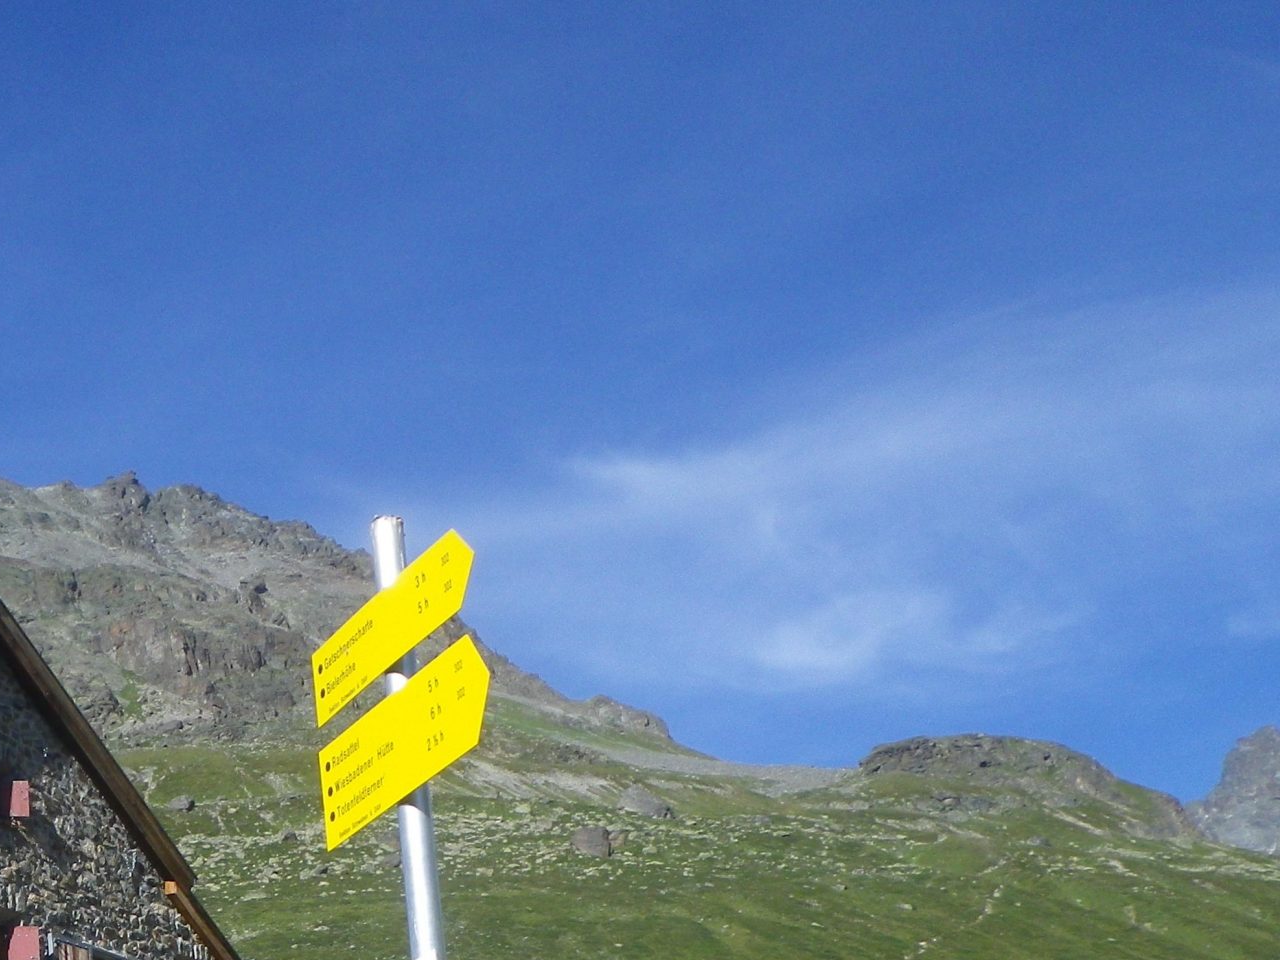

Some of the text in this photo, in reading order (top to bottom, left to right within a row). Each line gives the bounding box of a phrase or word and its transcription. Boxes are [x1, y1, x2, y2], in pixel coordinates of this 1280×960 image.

[415, 575, 420, 588] 3
[417, 601, 423, 614] 5
[331, 736, 361, 768] Radsattel
[427, 680, 433, 693] 5
[334, 756, 374, 793] Wiesbadener
[376, 740, 395, 760] Hütte
[429, 706, 436, 720] 6
[426, 737, 432, 752] 2
